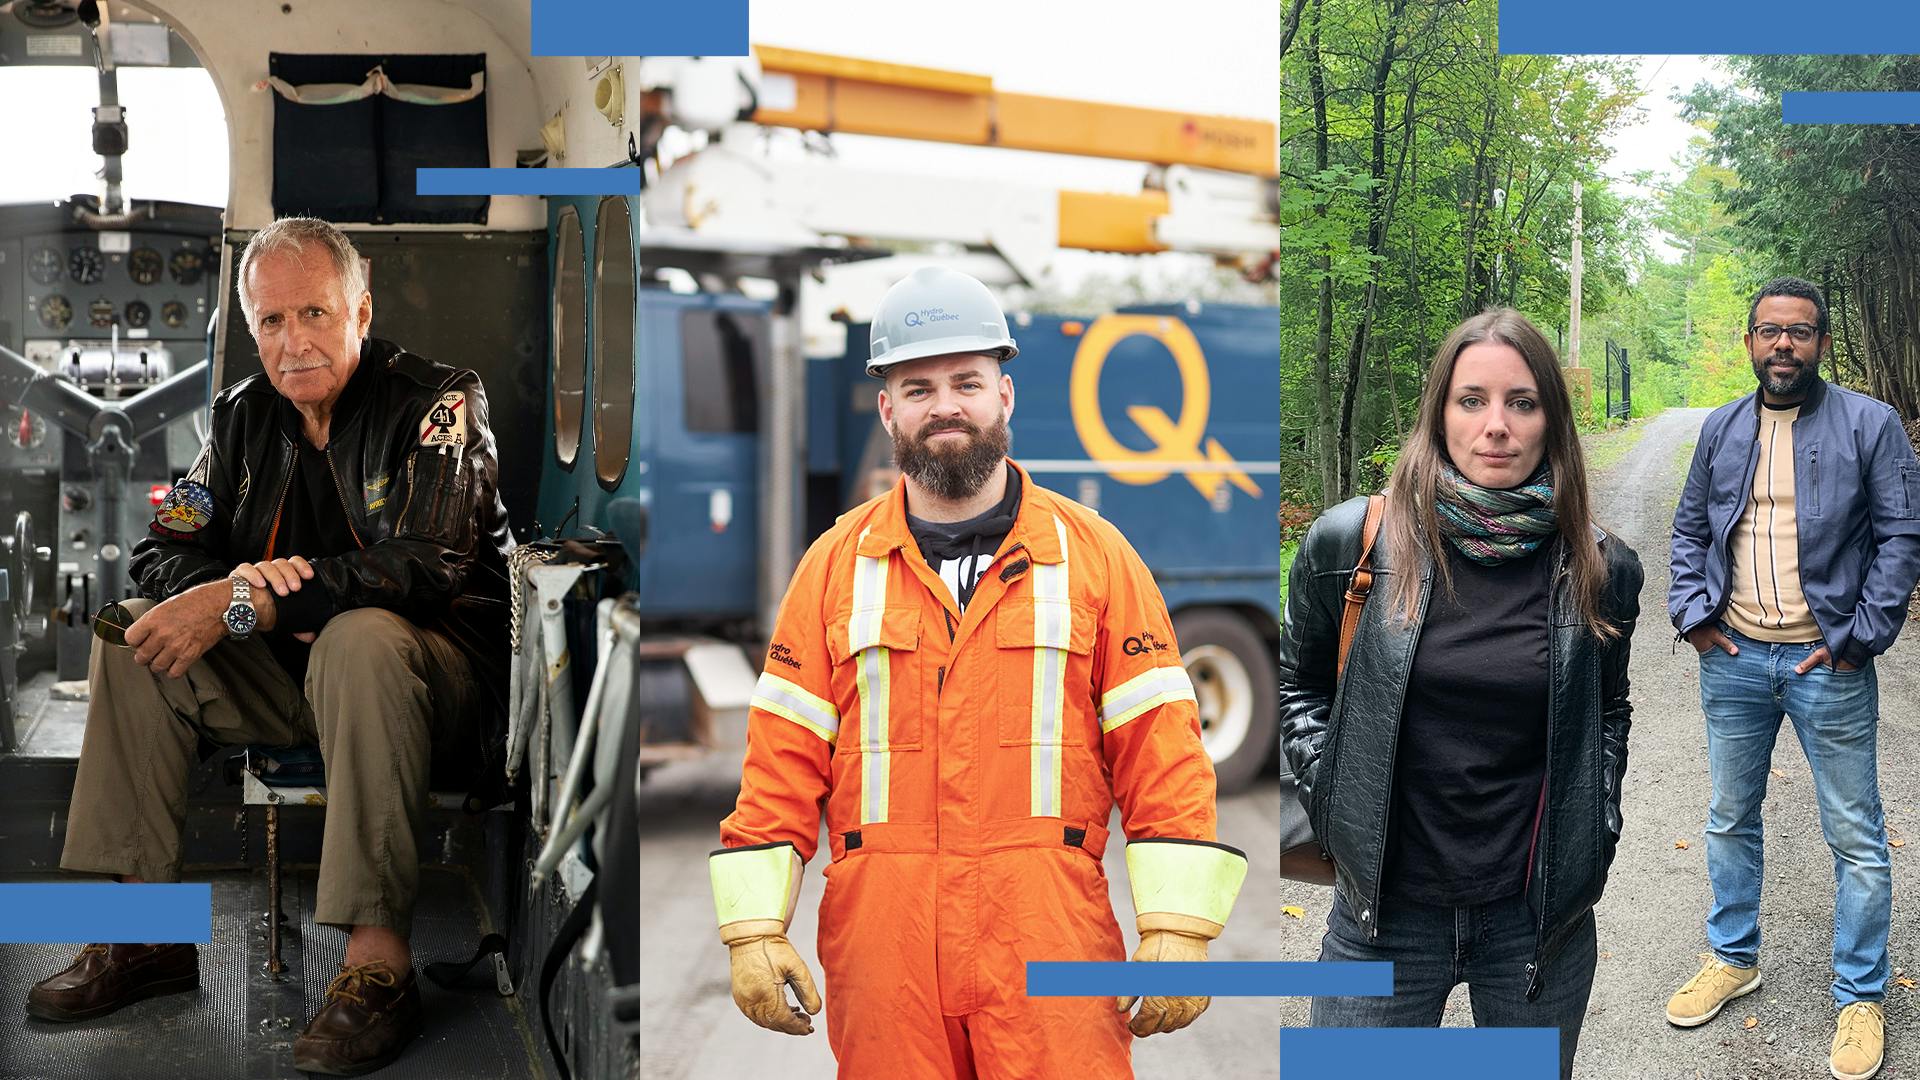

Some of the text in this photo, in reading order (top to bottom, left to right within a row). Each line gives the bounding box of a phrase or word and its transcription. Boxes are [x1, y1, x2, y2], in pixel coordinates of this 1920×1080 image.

[920, 308, 944, 317] Hydro
[929, 313, 960, 322] Québec
[433, 408, 452, 424] 41
[431, 434, 453, 443] ACES
[770, 643, 791, 655] ydro
[770, 650, 802, 670] Québec
